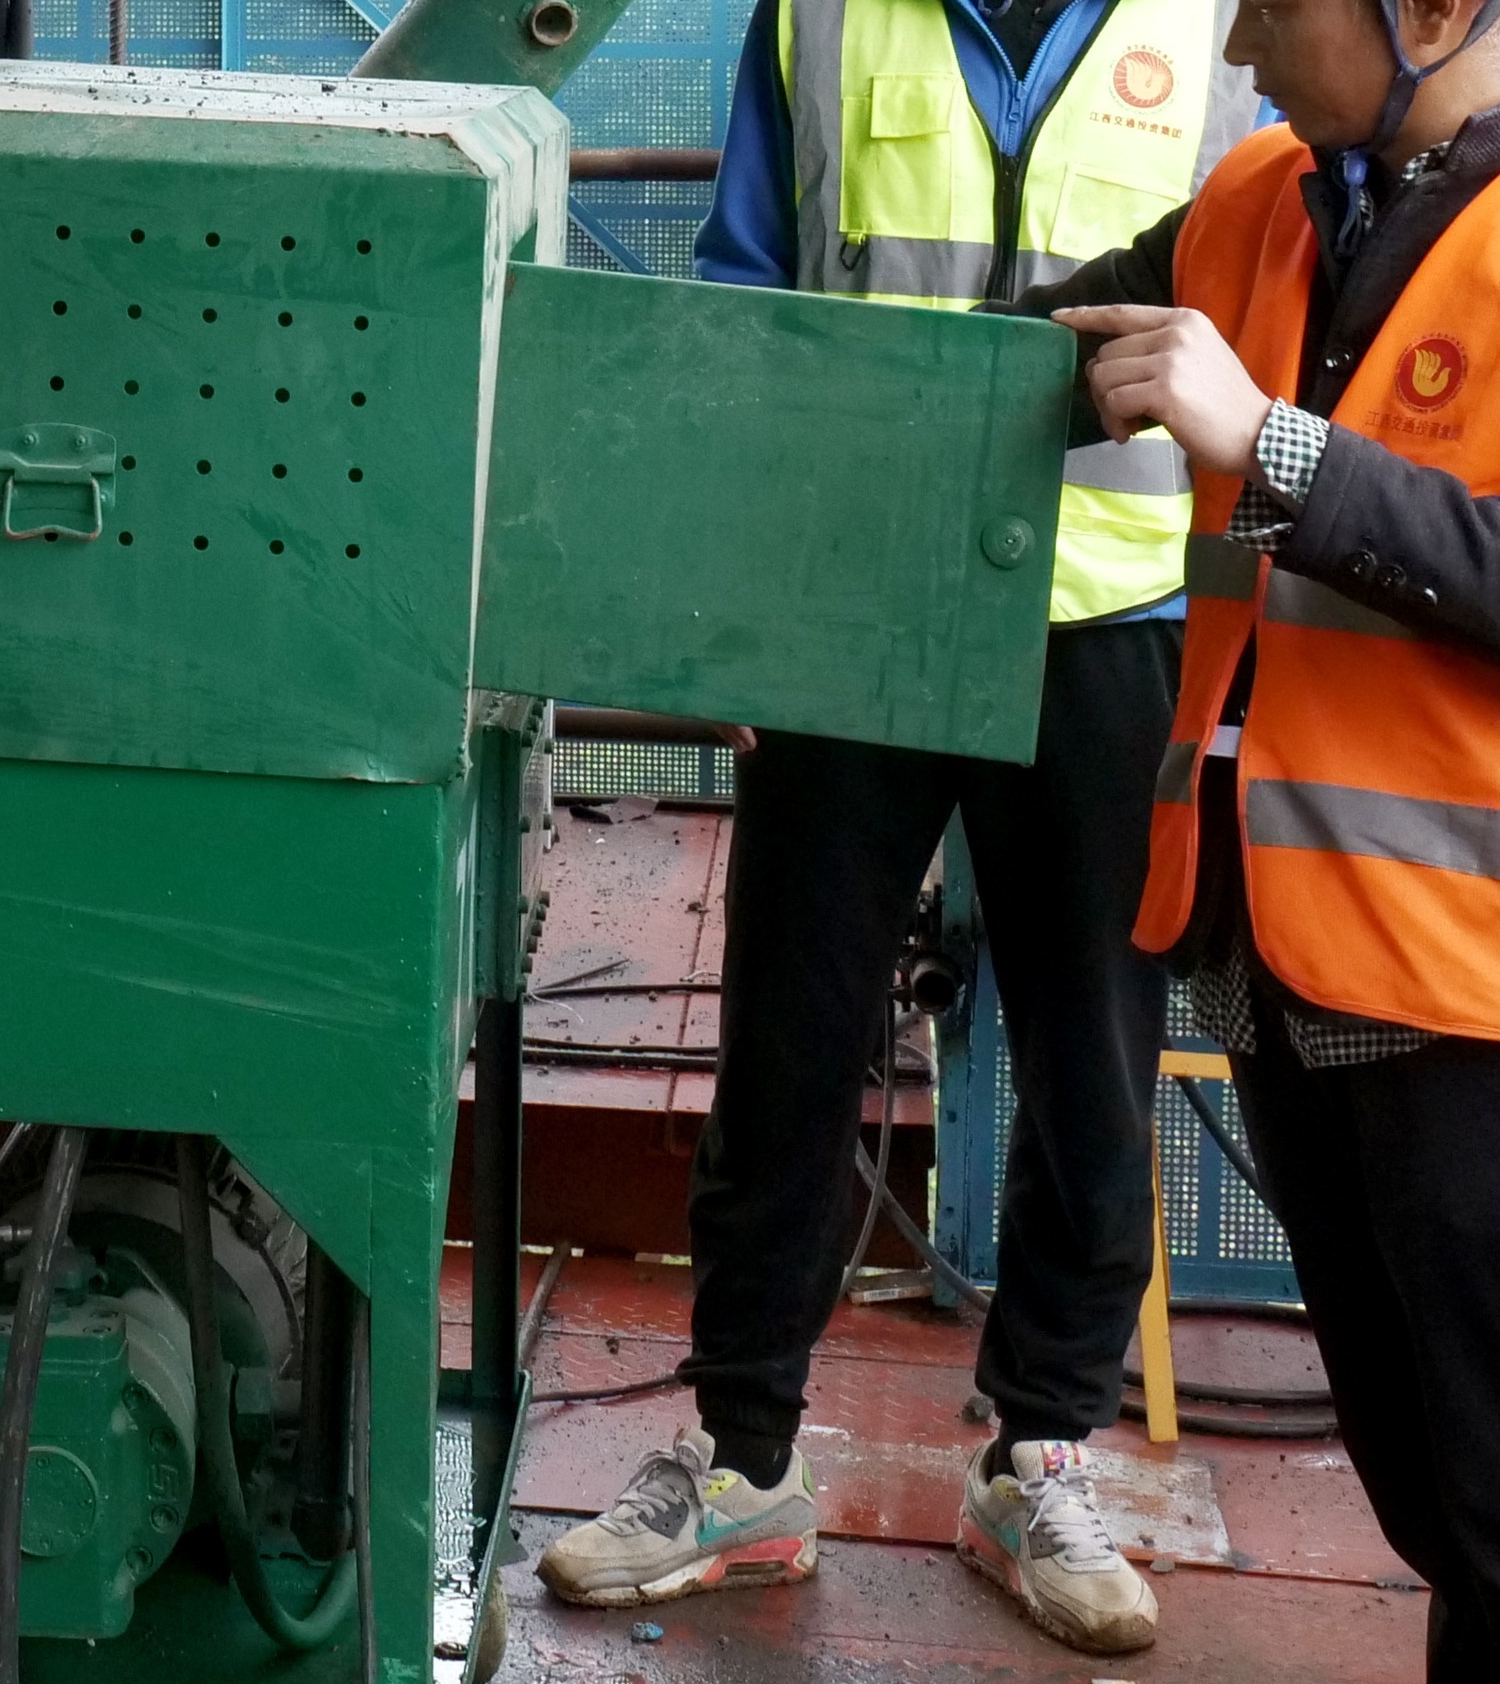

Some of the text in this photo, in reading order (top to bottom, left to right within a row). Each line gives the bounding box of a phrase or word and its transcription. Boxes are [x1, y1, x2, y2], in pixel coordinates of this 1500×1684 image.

[1089, 111, 1183, 139] 江西交通投资集团
